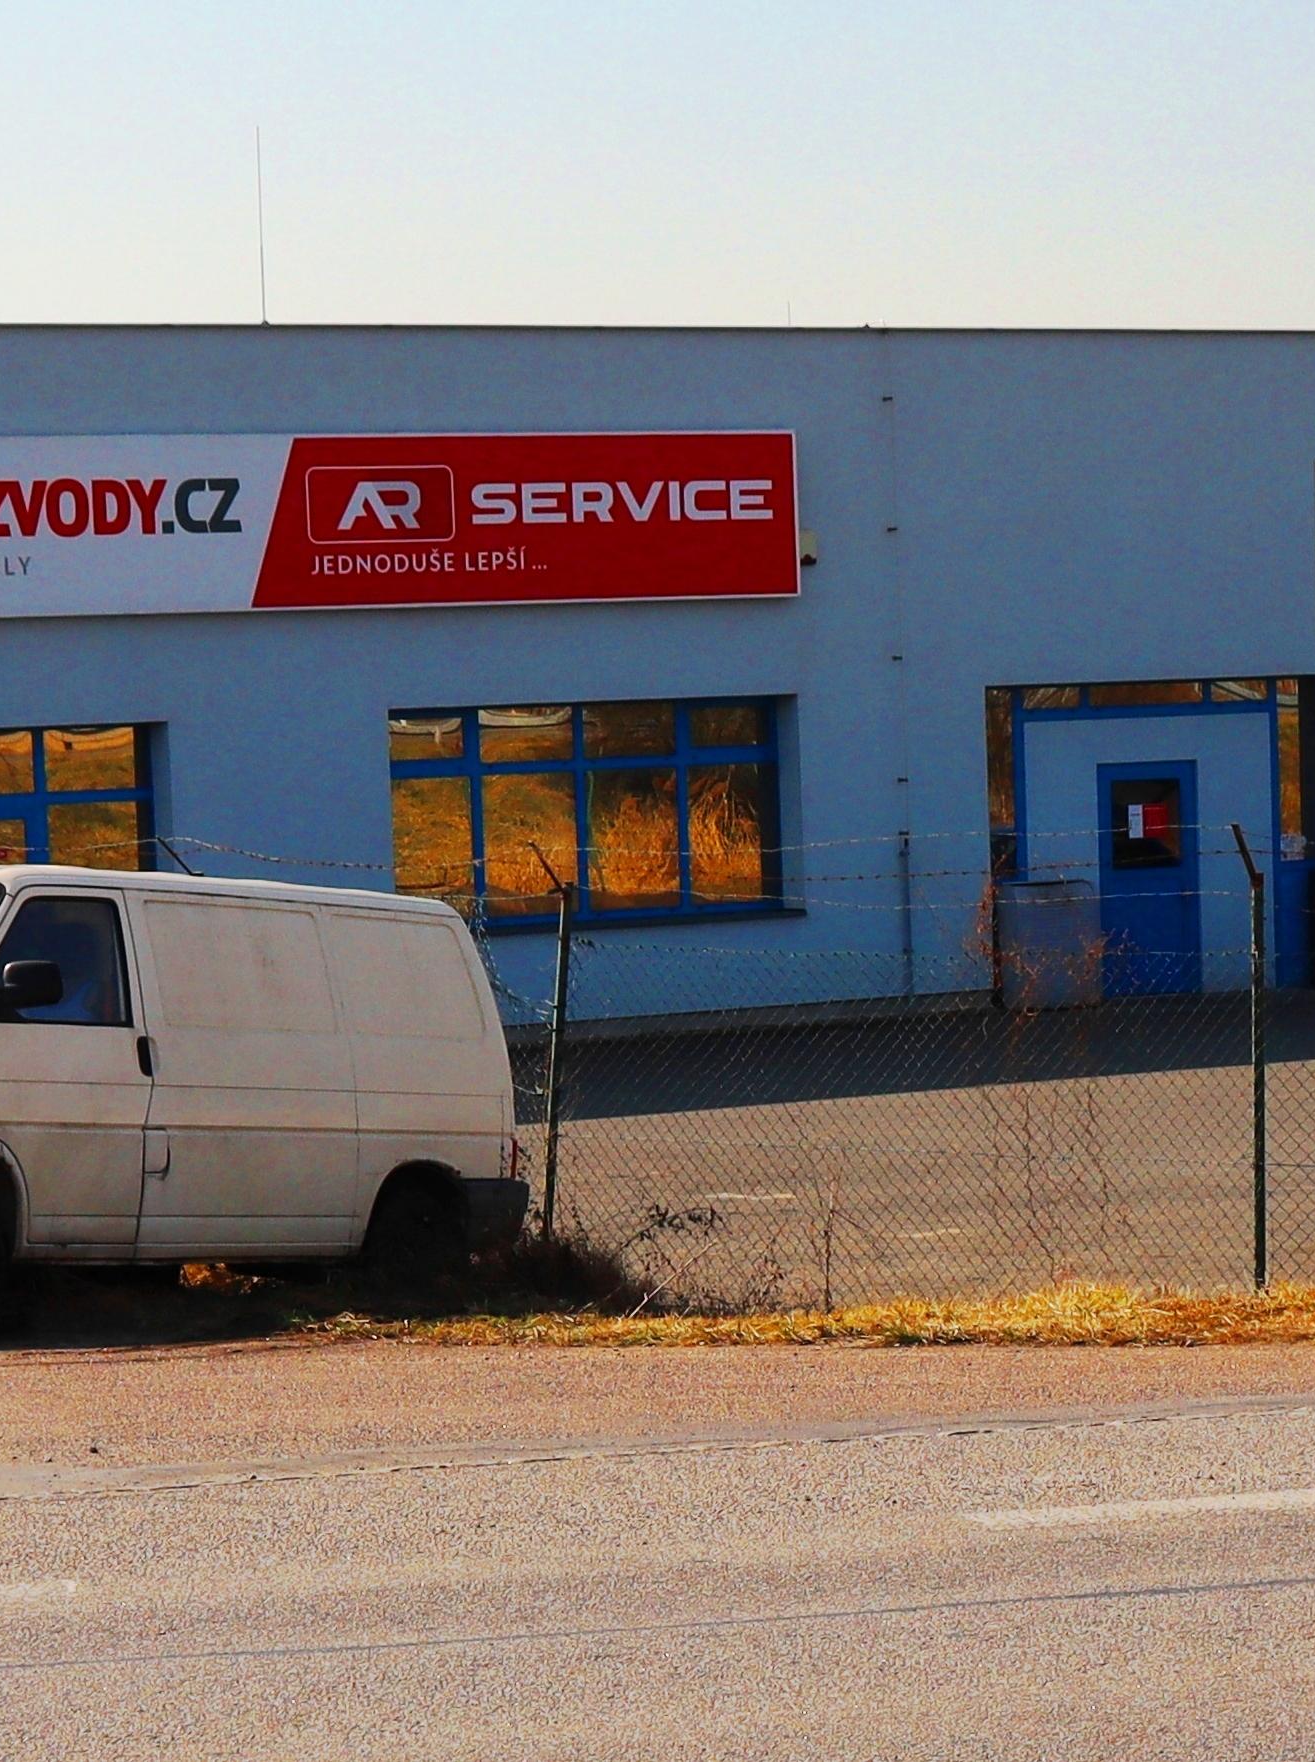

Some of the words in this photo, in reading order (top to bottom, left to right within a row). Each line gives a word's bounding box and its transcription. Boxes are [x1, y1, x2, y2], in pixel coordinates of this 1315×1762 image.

[337, 481, 421, 530] AR
[471, 479, 773, 525] SERVICE
[311, 548, 455, 575] JEDNODUŠE
[465, 546, 526, 571] LEPŠÍ
